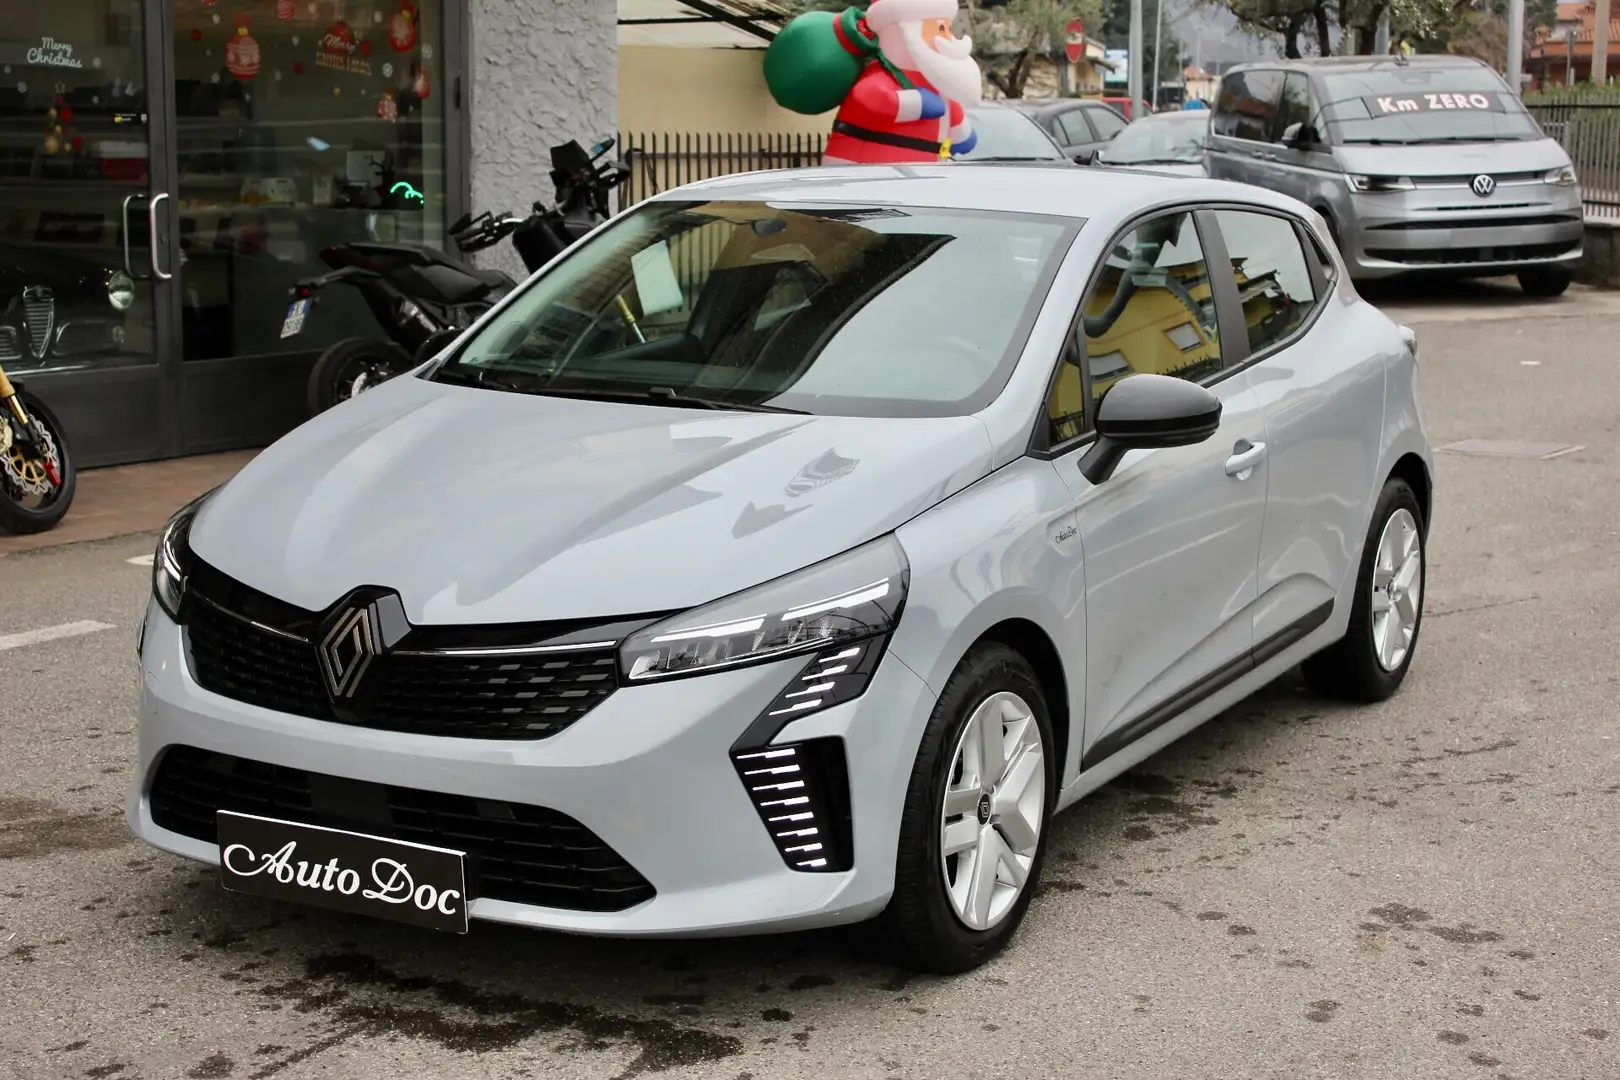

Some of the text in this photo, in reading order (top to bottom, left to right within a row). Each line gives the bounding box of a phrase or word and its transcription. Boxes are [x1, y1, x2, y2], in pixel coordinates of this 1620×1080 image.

[41, 36, 73, 57] Merry
[27, 47, 83, 68] Christmas
[1377, 93, 1489, 113] Km ZERO
